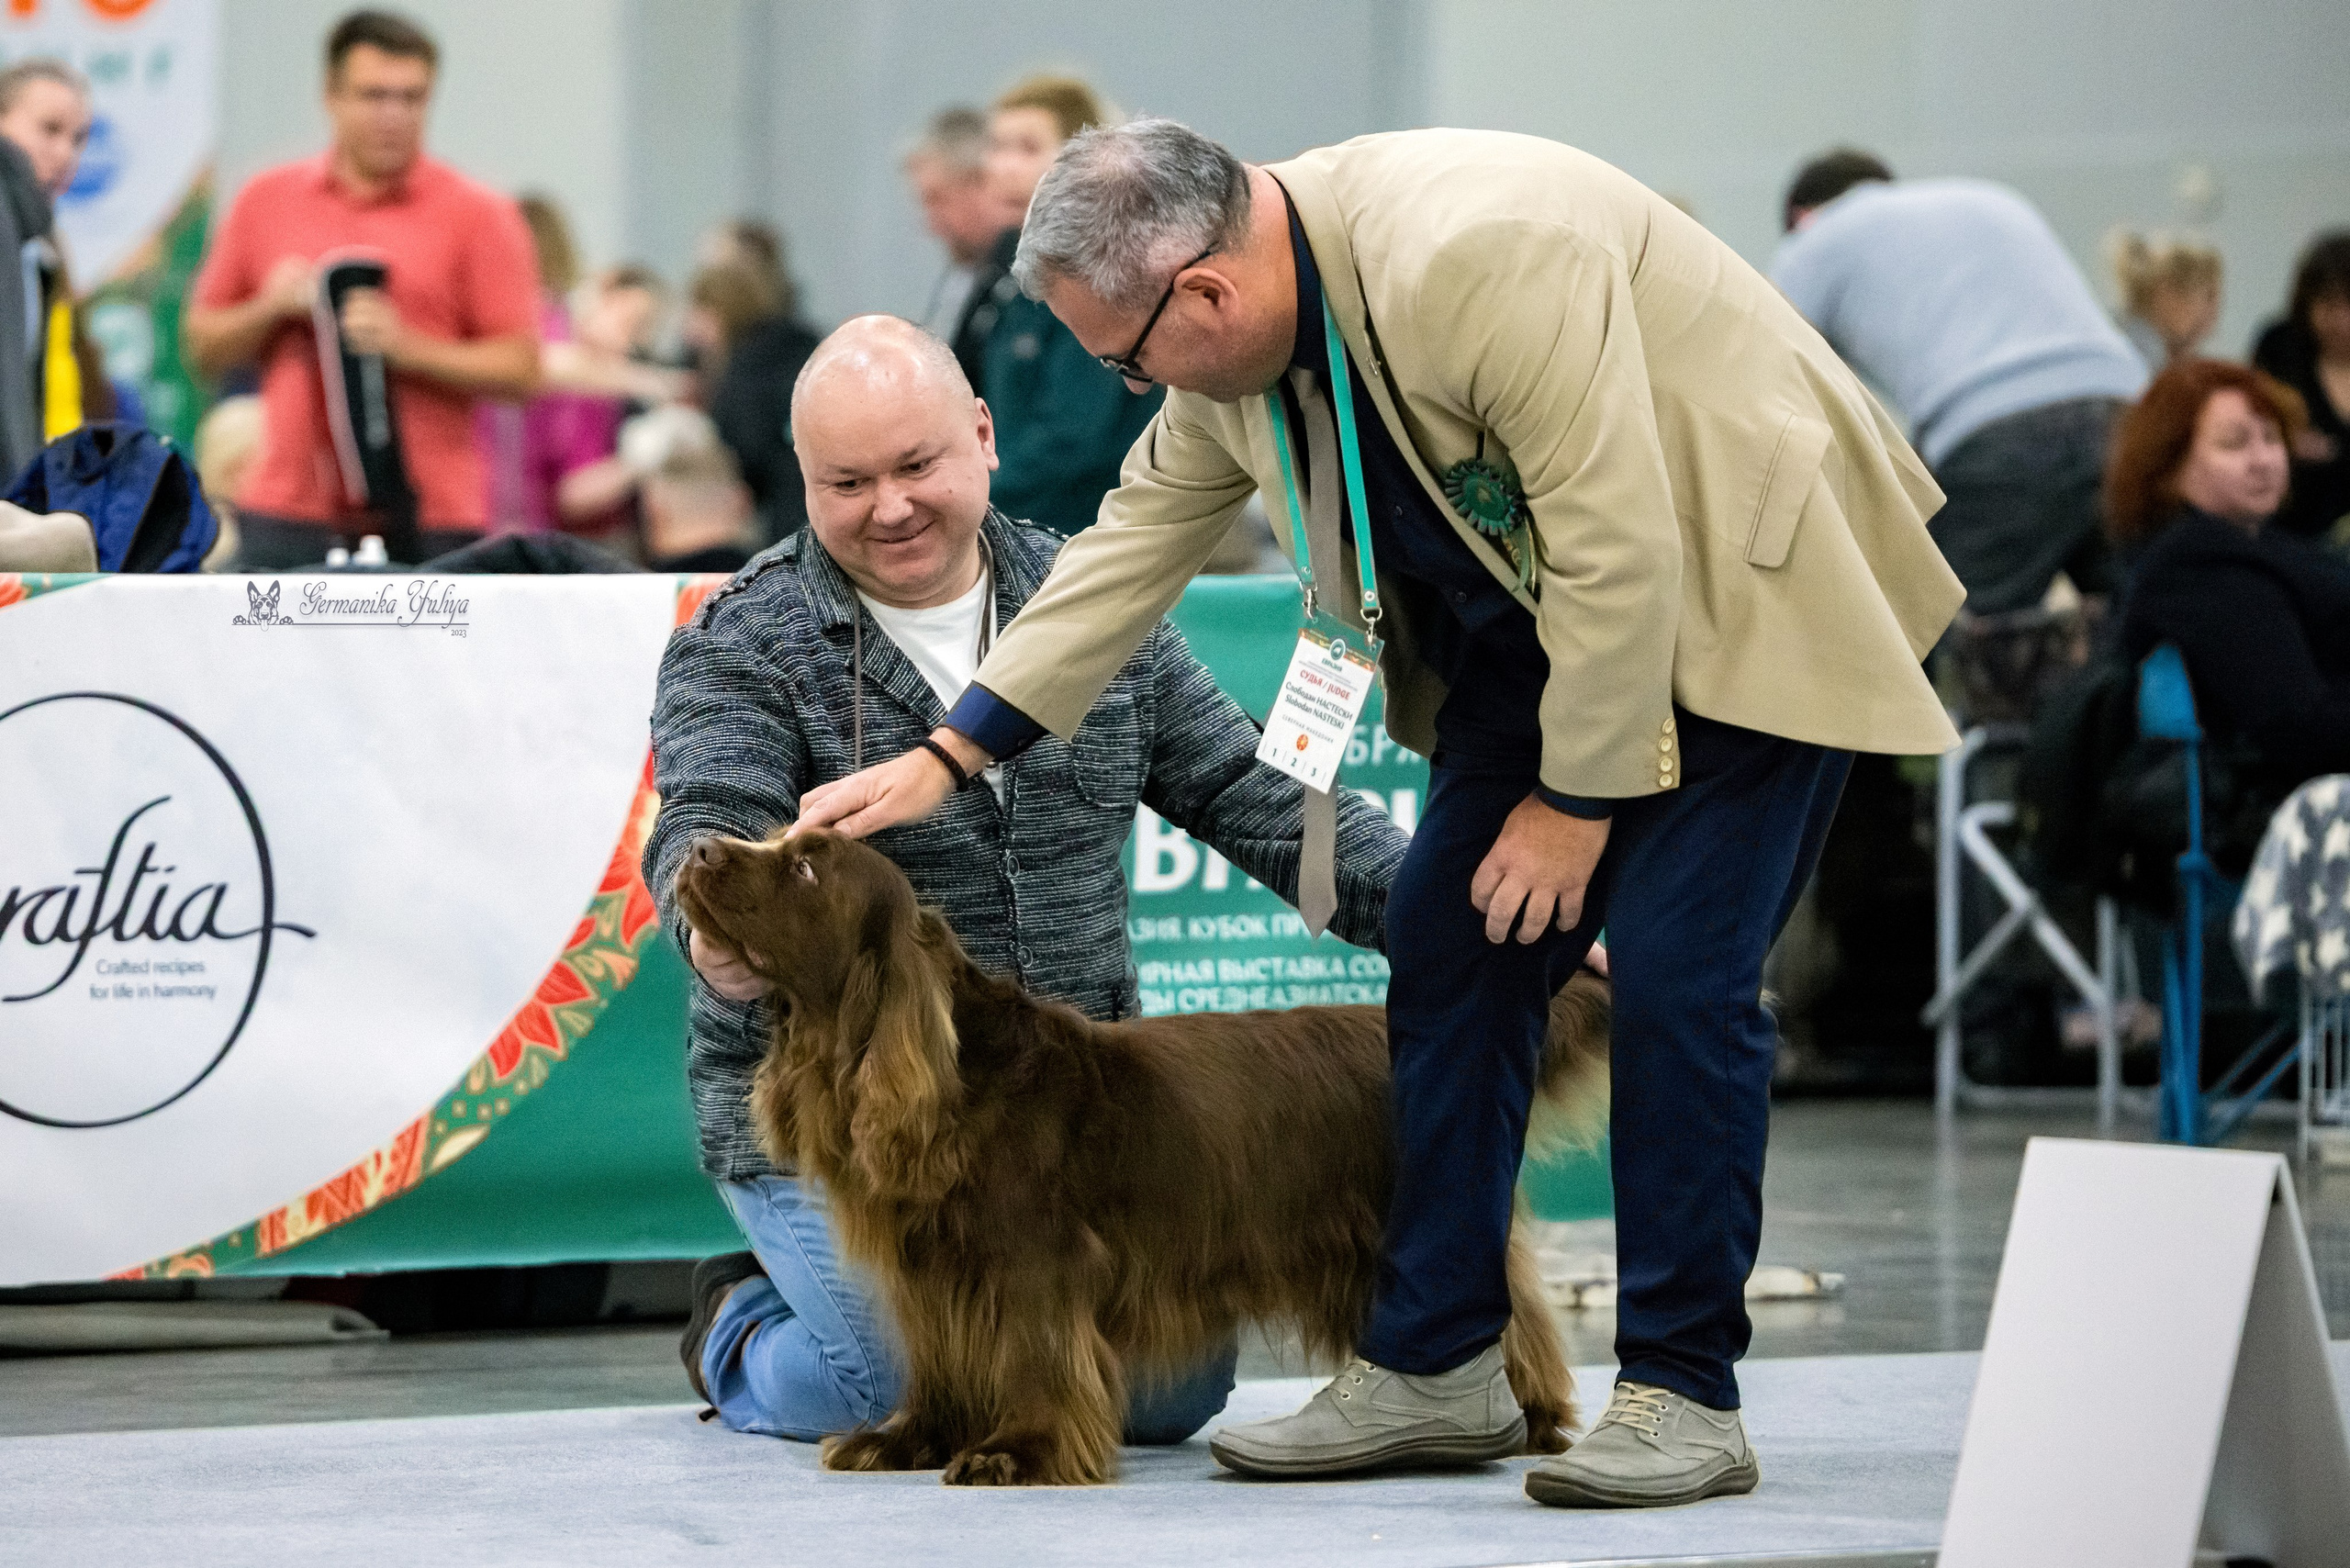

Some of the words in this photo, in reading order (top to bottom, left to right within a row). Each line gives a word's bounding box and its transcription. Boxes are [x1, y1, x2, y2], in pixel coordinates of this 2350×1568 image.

[1300, 669, 1323, 687] СУДЬЯ
[1326, 683, 1350, 700] JUDGE
[1285, 681, 1315, 702] Слободан
[1316, 697, 1353, 721] НАСТЕСКИ
[1285, 694, 1312, 713] Slobodan
[1313, 709, 1345, 730] NASTESKI
[95, 958, 150, 975] Crafted
[152, 958, 206, 976] recipes
[1216, 956, 1347, 983] ВЫСТАВКА
[90, 983, 109, 999] for
[112, 982, 134, 998] life
[138, 983, 151, 997] in
[152, 982, 217, 1000] harmony
